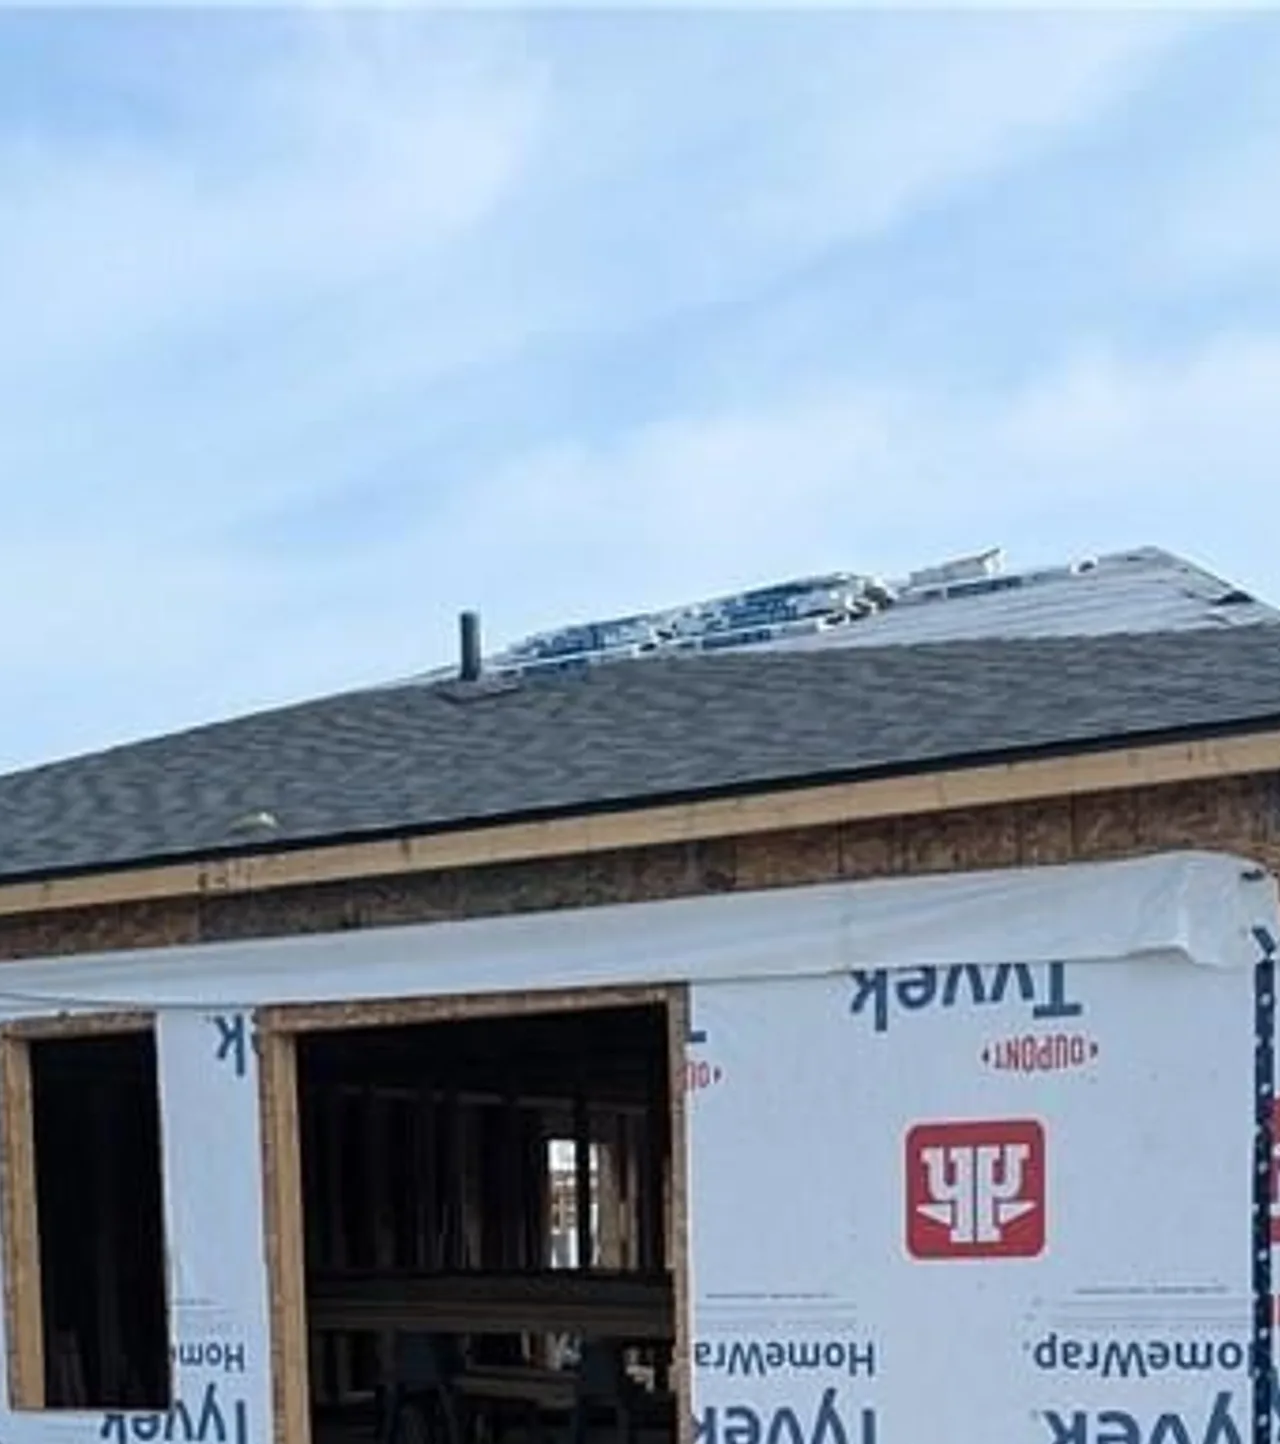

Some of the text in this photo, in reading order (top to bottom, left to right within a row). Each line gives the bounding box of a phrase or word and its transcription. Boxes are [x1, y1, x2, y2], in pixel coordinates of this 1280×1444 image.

[993, 1035, 1084, 1071] DUPONT
[694, 1340, 874, 1377] HomeWra
[1034, 1338, 1255, 1379] omeWrap
